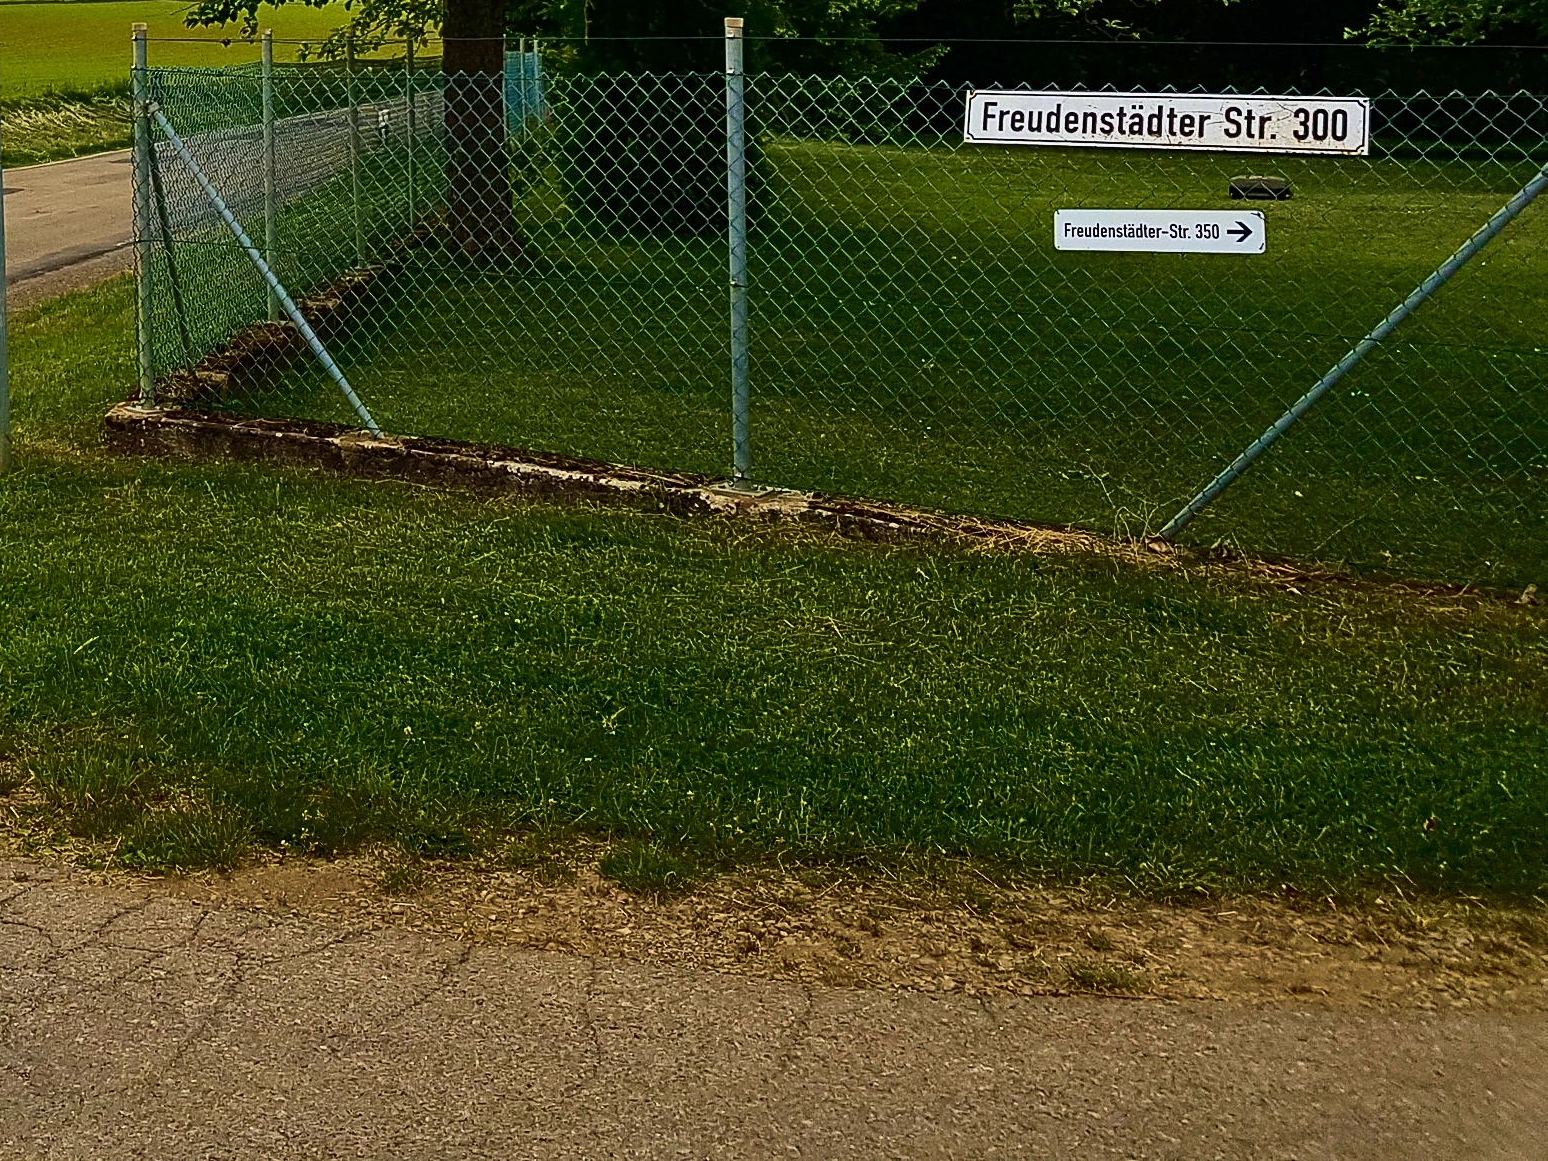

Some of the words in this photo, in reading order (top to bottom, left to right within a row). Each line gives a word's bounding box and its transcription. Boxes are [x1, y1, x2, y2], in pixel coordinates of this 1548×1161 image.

[982, 101, 1211, 138] Freudenstädter
[1223, 106, 1277, 140] Str.
[1292, 107, 1348, 142] 300
[1195, 223, 1220, 239] 350
